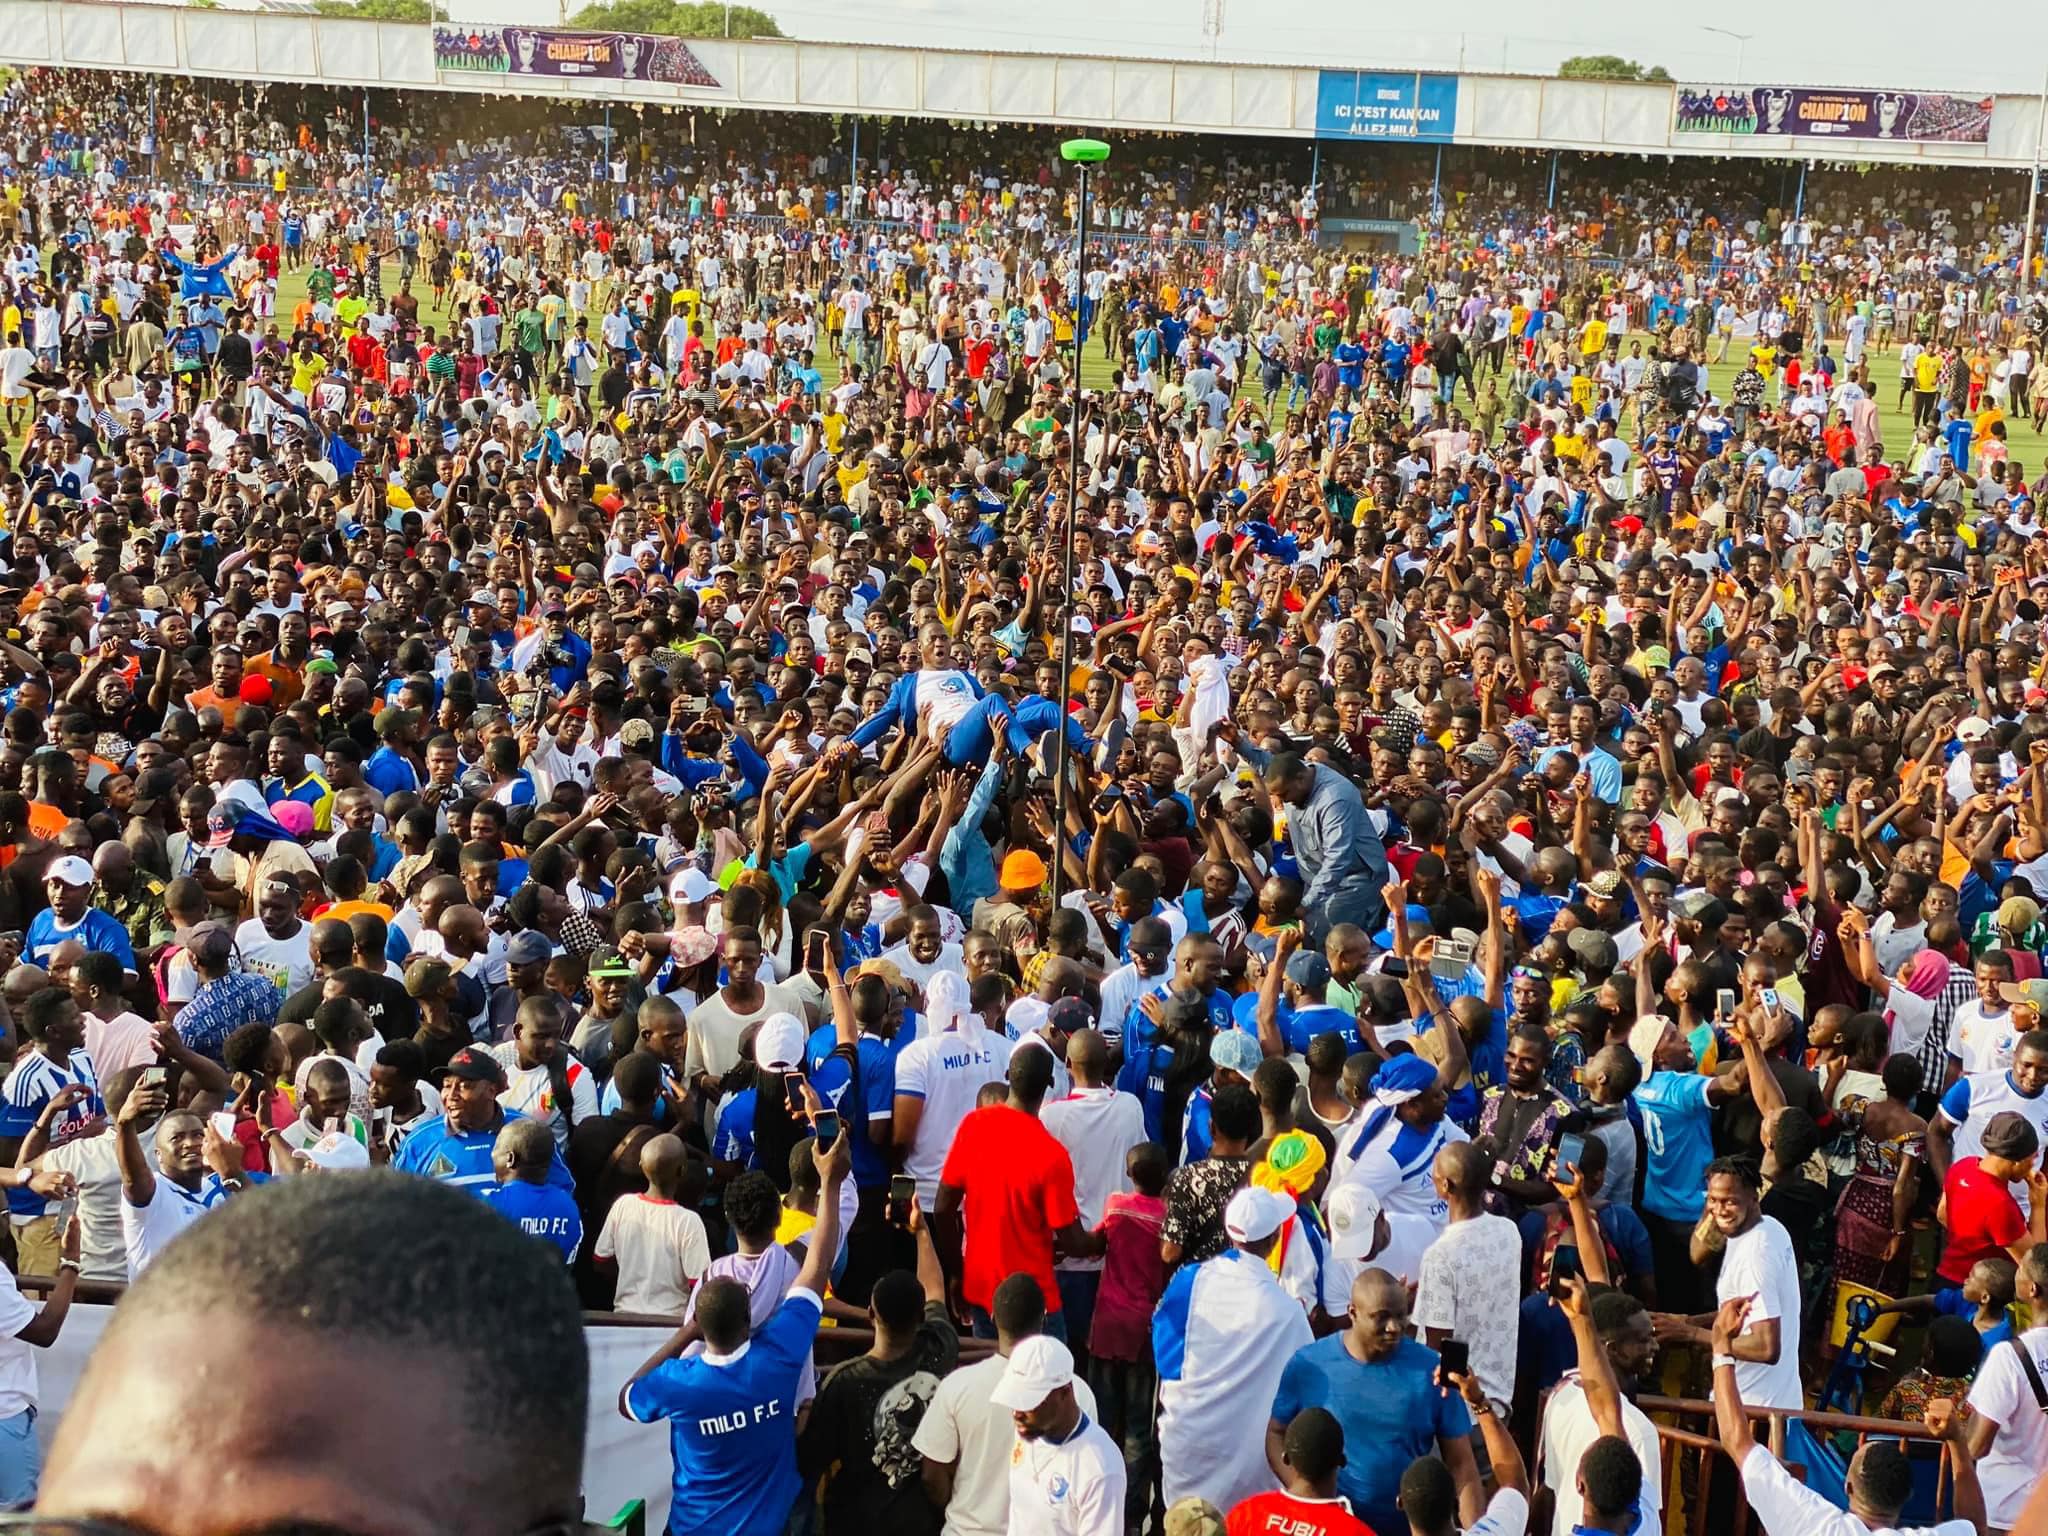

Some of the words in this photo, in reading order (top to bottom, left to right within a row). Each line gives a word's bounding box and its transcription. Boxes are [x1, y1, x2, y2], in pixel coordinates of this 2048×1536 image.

[1334, 105, 1351, 117] ICI
[1354, 105, 1388, 119] C'EST
[1343, 222, 1399, 232] VESTIAIRE
[943, 1053, 970, 1070] MILO
[520, 1218, 548, 1235] MILO
[552, 1218, 568, 1235] F.C
[699, 1411, 747, 1436] MILO
[753, 1399, 780, 1424] F.C
